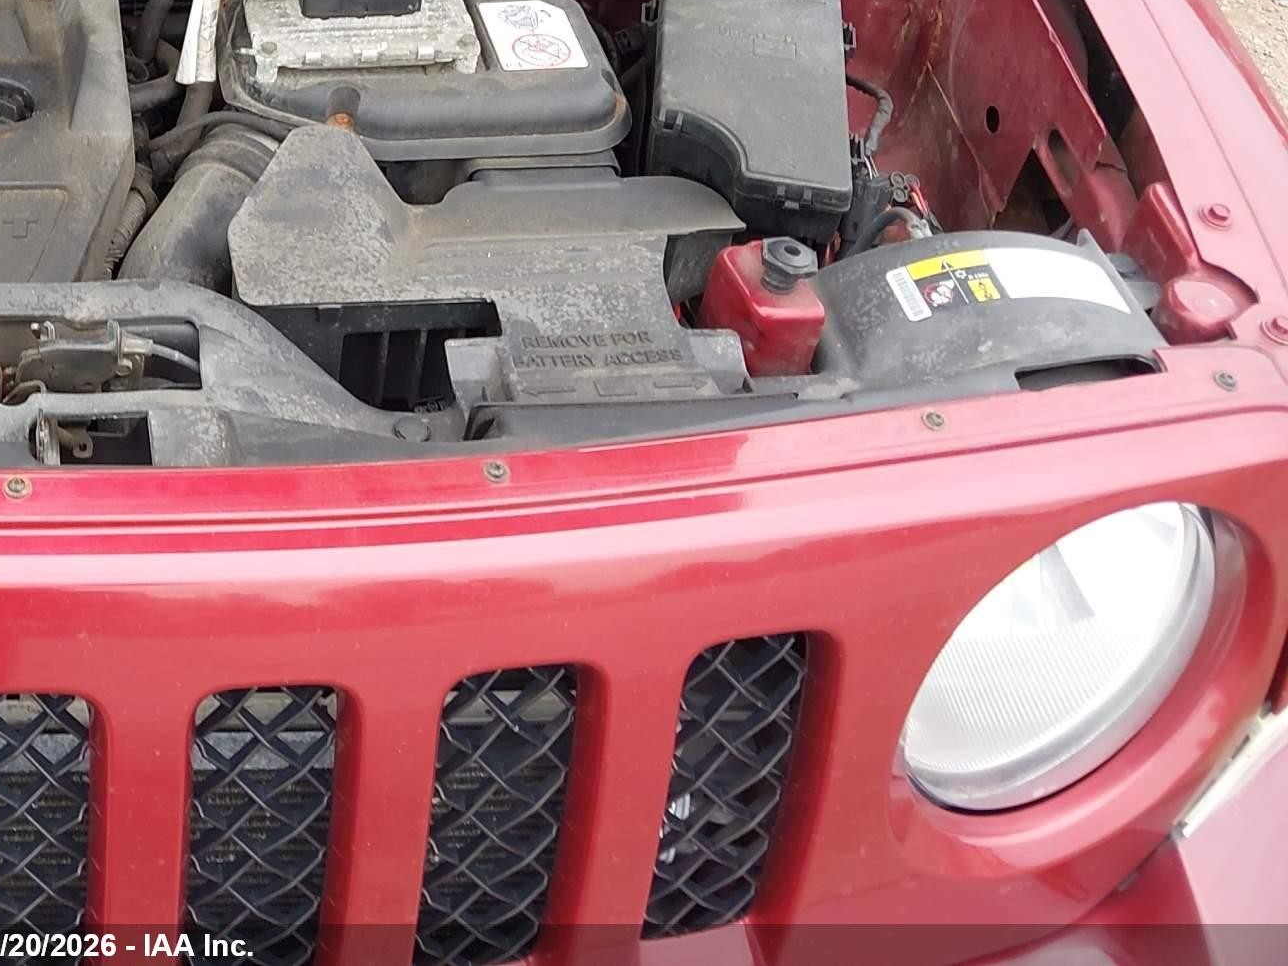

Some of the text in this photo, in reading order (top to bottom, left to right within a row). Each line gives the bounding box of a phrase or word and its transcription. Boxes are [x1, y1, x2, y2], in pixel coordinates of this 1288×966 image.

[521, 330, 654, 349] REMOVE FOR
[511, 348, 683, 369] BATTERY ACCESS
